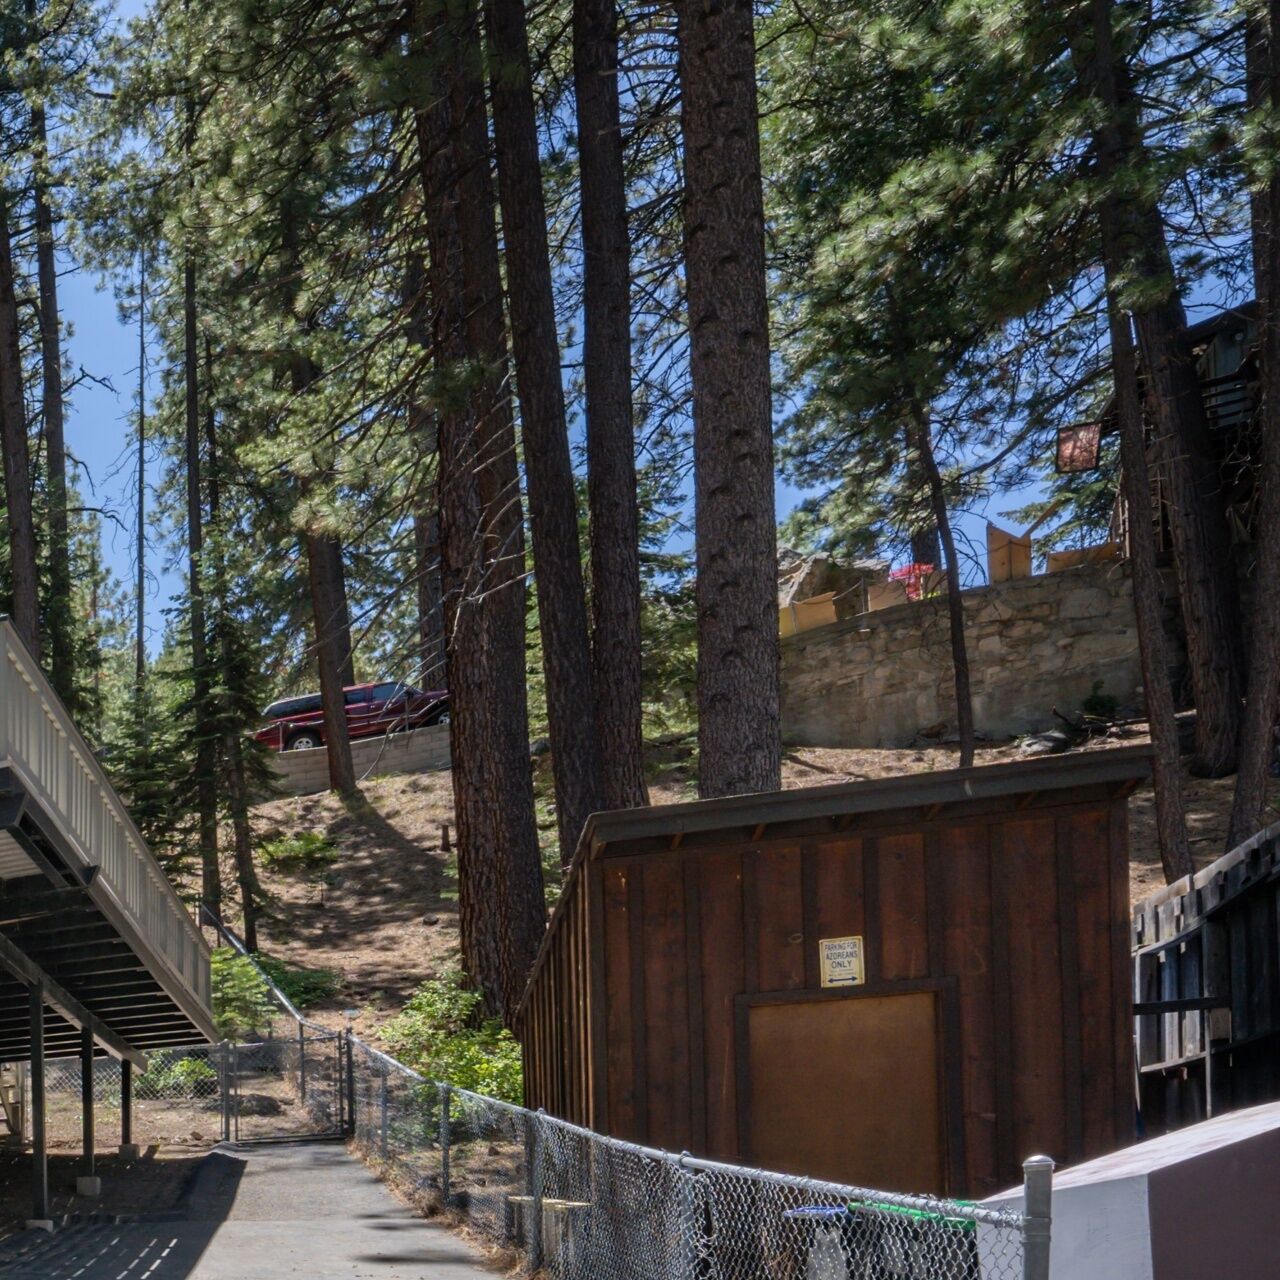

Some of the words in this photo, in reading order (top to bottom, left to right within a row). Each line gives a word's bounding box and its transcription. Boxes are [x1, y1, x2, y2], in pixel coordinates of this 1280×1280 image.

[825, 942, 846, 951] PARKING
[847, 941, 857, 949] FOR
[826, 950, 857, 960] AZOREANS
[831, 960, 852, 969] ONLY
